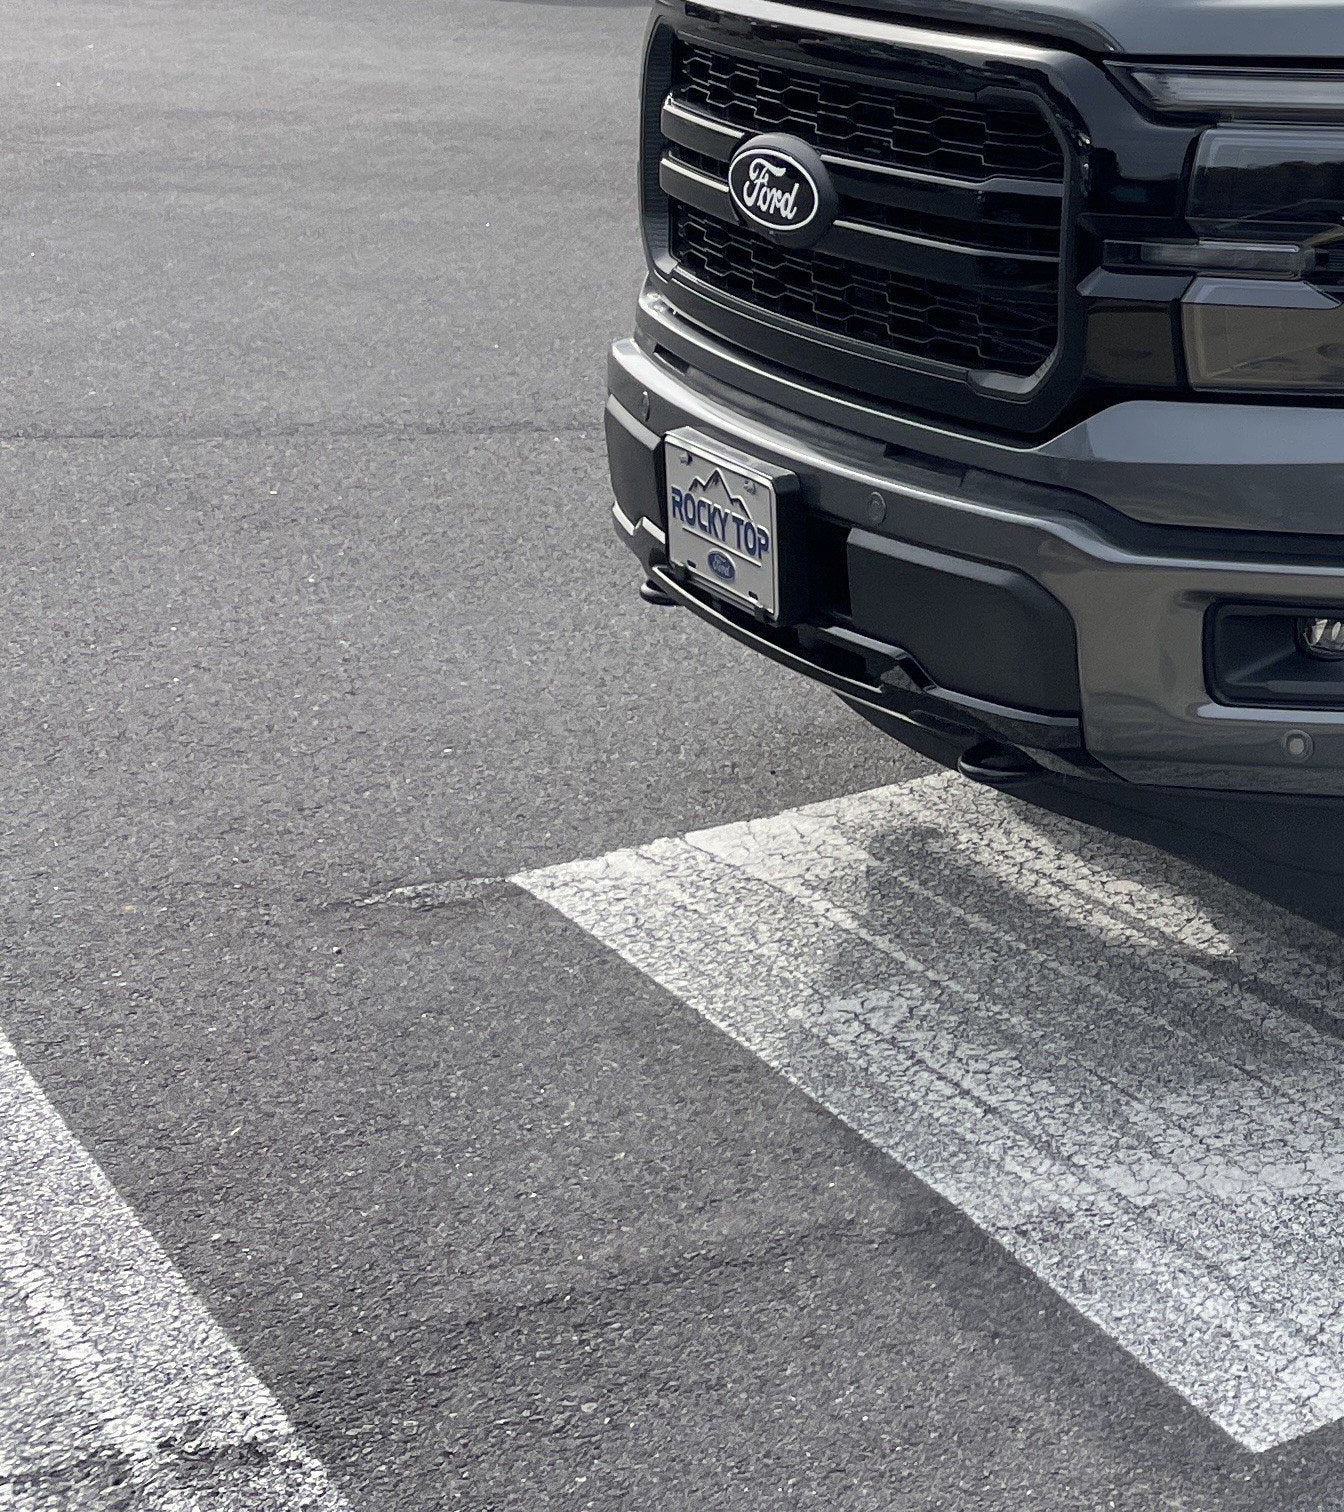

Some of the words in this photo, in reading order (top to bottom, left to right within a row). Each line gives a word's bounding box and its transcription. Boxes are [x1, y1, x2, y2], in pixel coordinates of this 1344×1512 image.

[743, 158, 799, 219] Ford
[671, 486, 729, 542] ROCKY
[731, 512, 769, 559] TOP
